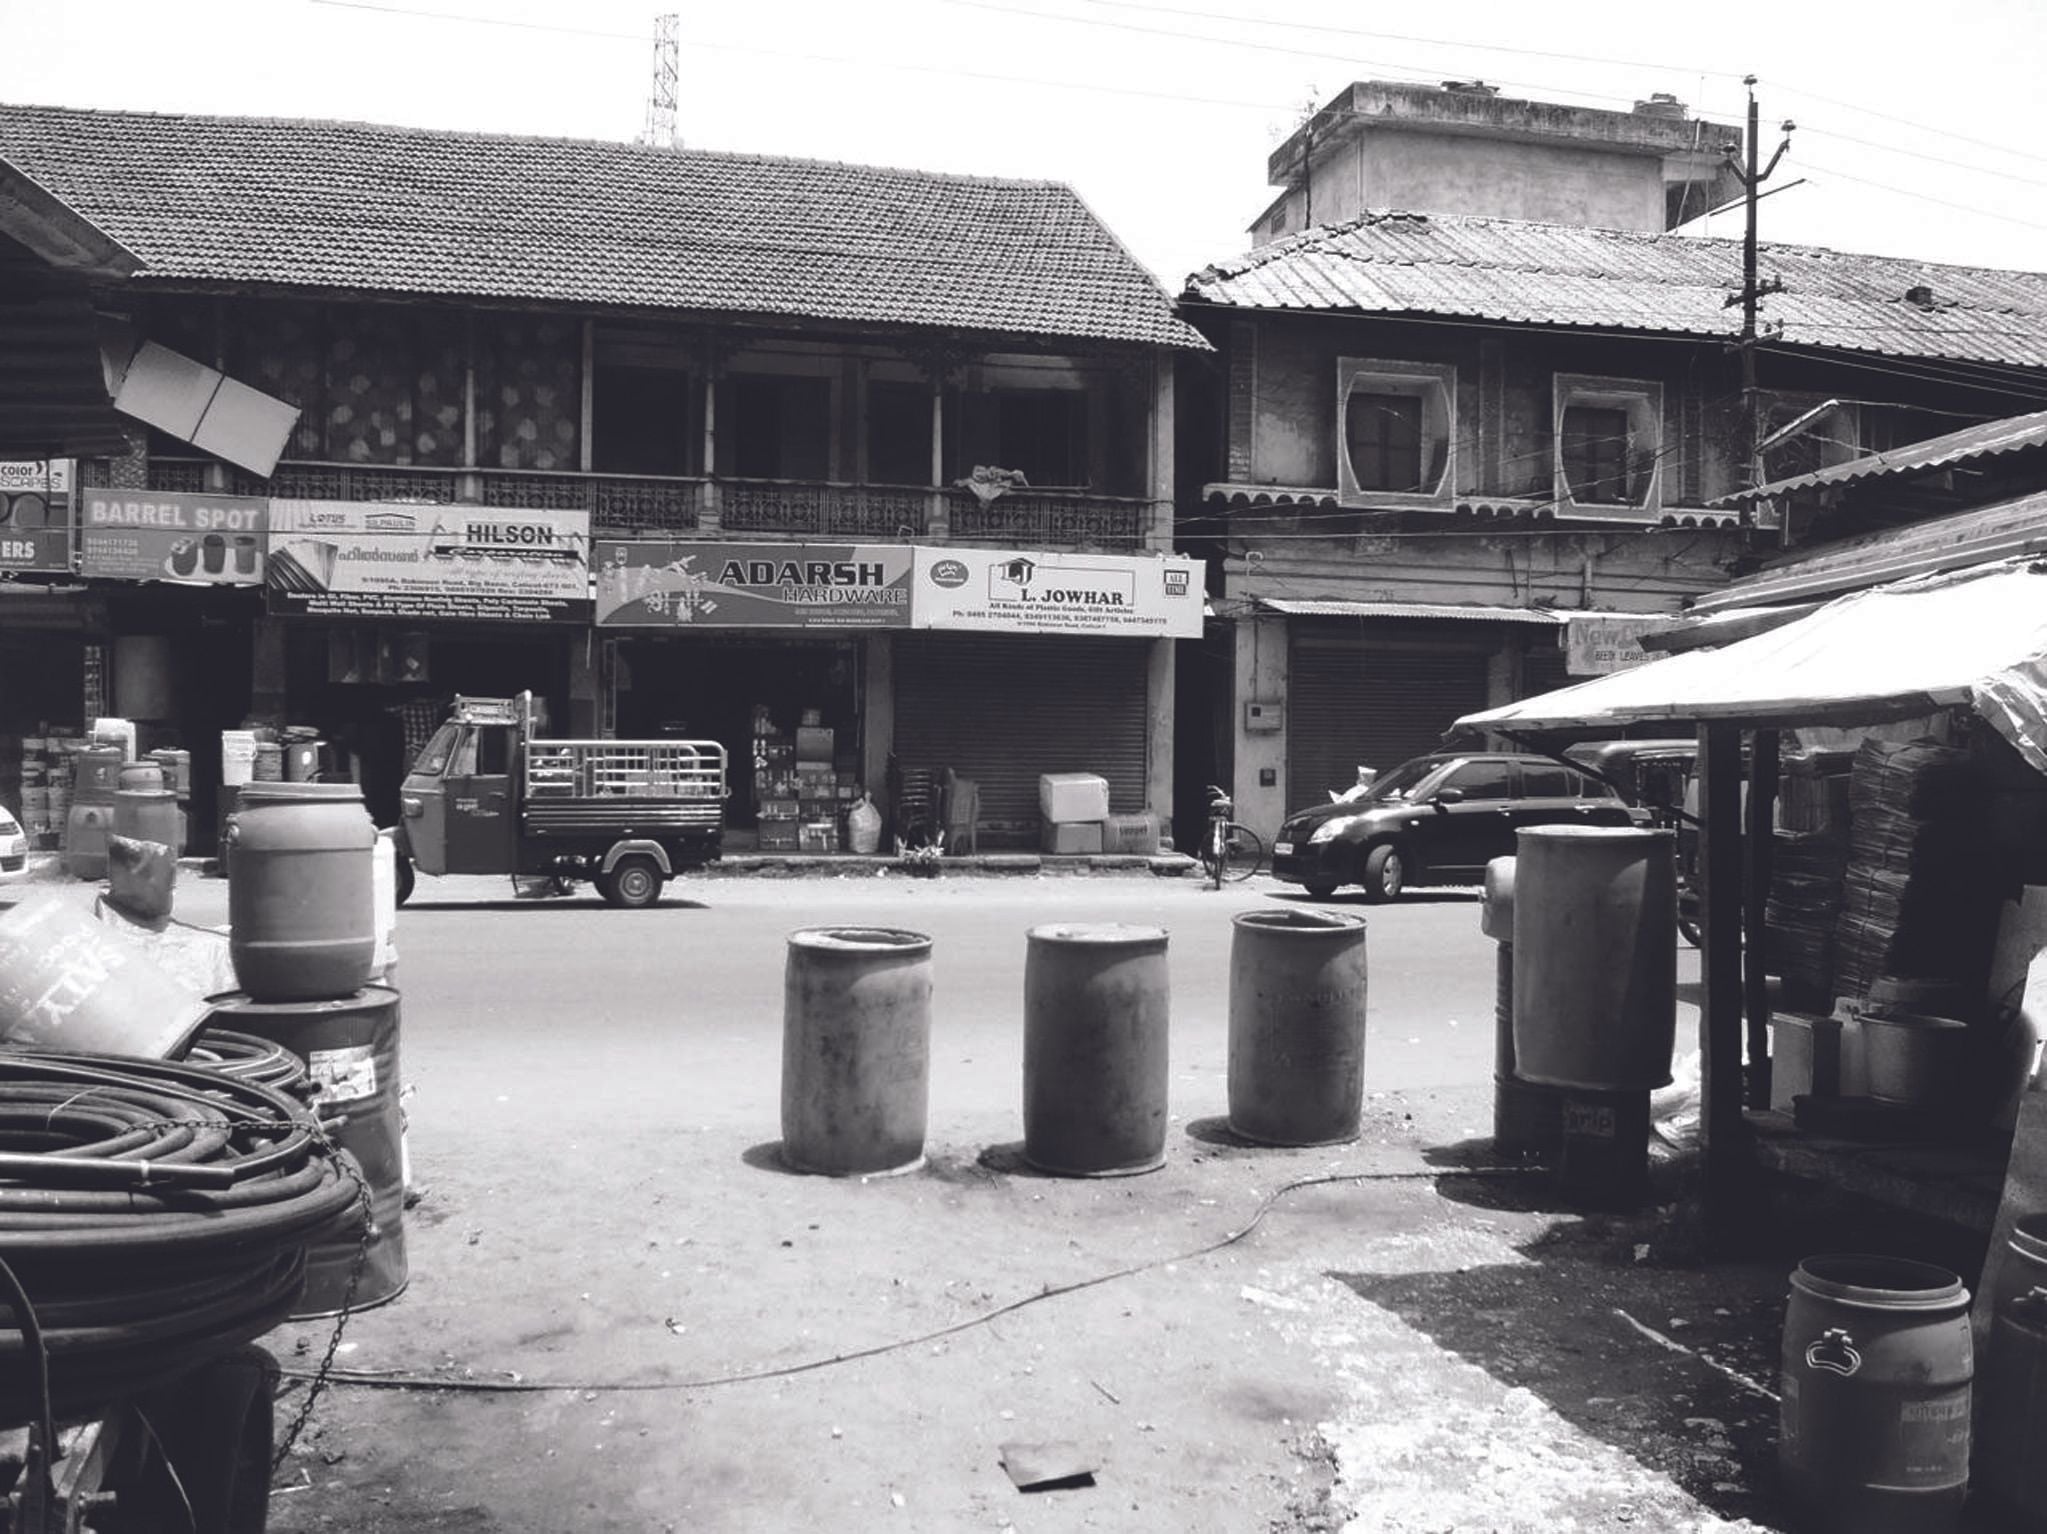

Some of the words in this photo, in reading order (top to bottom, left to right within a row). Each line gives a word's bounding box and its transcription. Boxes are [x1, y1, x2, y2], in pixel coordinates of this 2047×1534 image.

[92, 501, 187, 527] BARREL
[194, 508, 260, 530] SPOT
[466, 523, 553, 545] HILSON
[1, 540, 36, 559] ERS
[718, 559, 885, 587] ADARSH
[783, 586, 908, 605] HARDWARE
[1021, 588, 1037, 603] L.
[1041, 588, 1124, 606] JOWHAR
